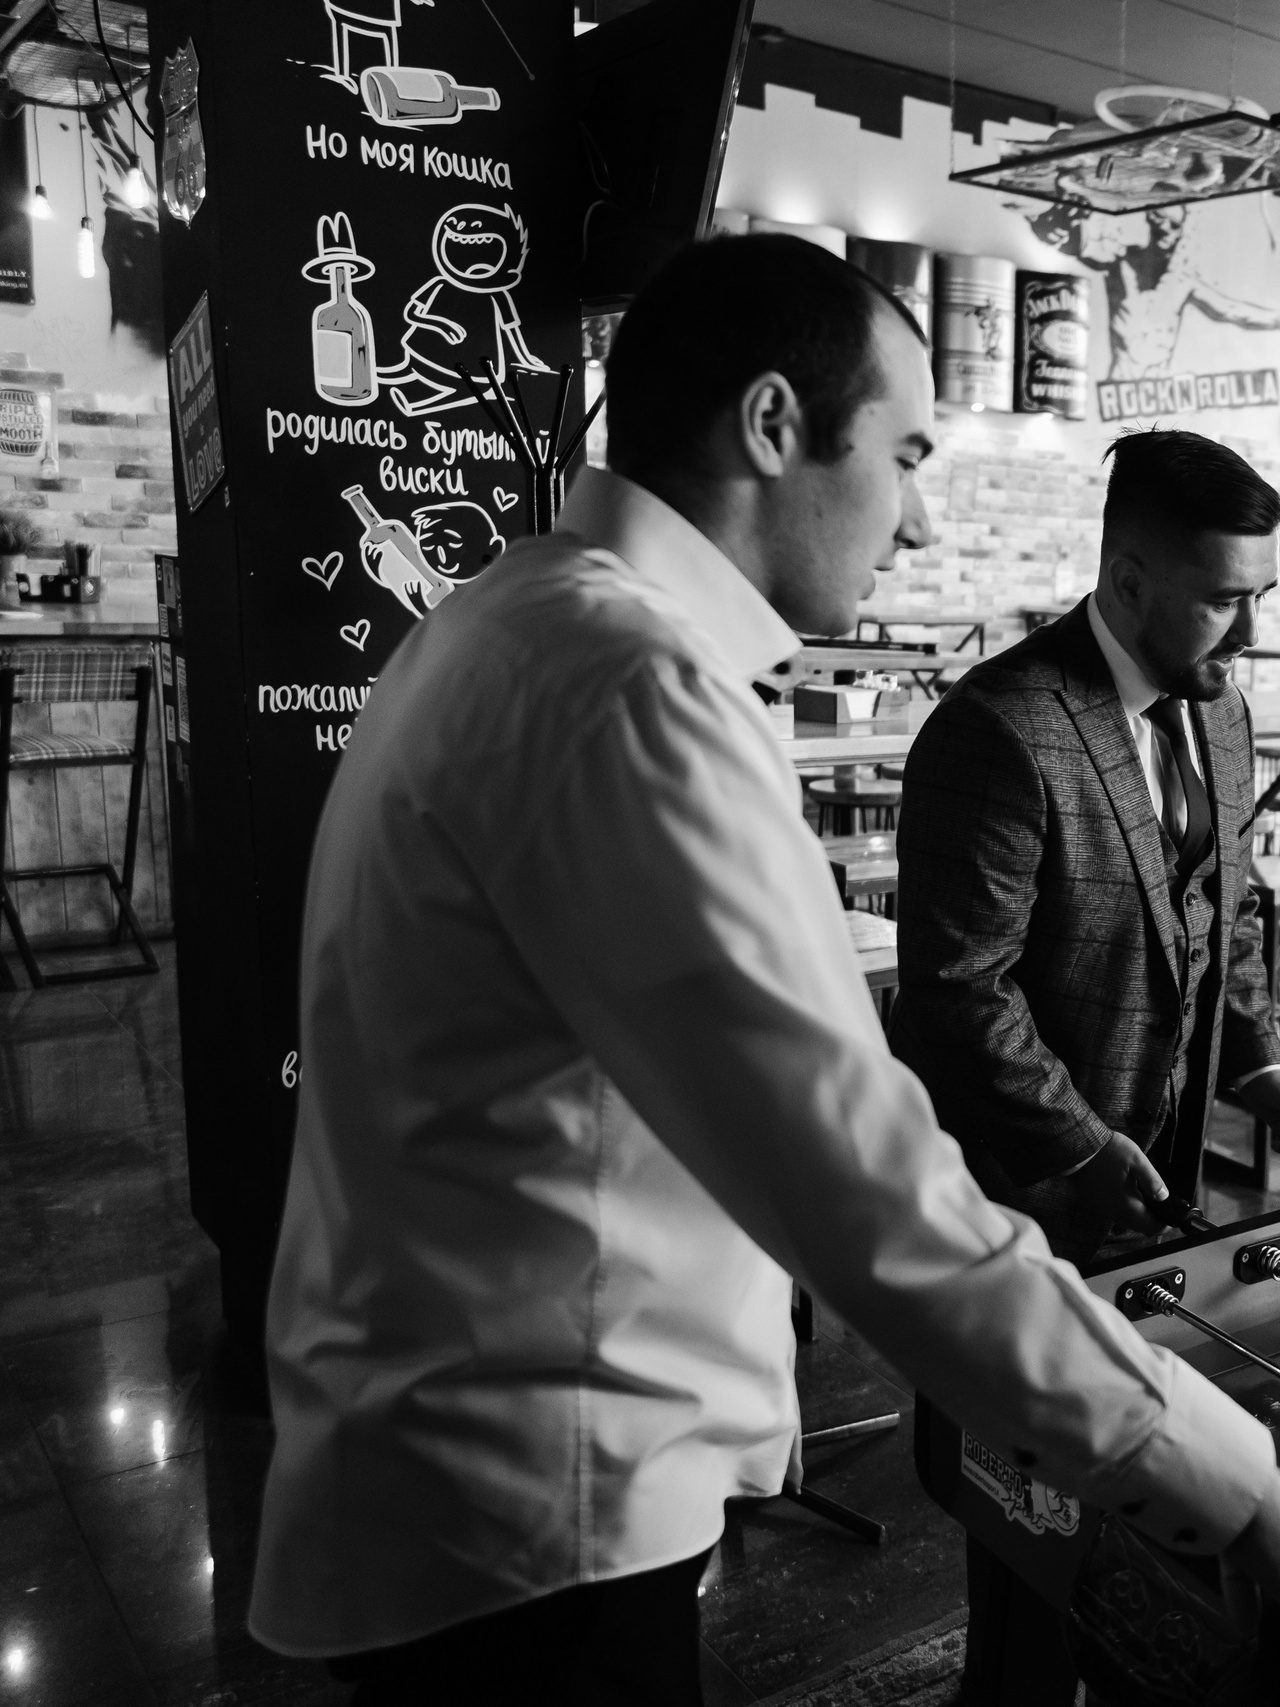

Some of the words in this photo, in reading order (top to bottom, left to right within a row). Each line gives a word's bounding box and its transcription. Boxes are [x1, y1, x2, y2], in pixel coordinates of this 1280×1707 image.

[424, 145, 514, 191] кошка
[180, 318, 212, 404] ALL
[183, 400, 198, 438] you
[198, 368, 215, 414] need
[0, 427, 43, 440] MOOTH
[266, 407, 408, 455] родилась
[422, 420, 559, 466] бутылй
[379, 455, 469, 495] виски
[258, 677, 378, 721] пожалу
[964, 1432, 1023, 1498] ROBERTO
